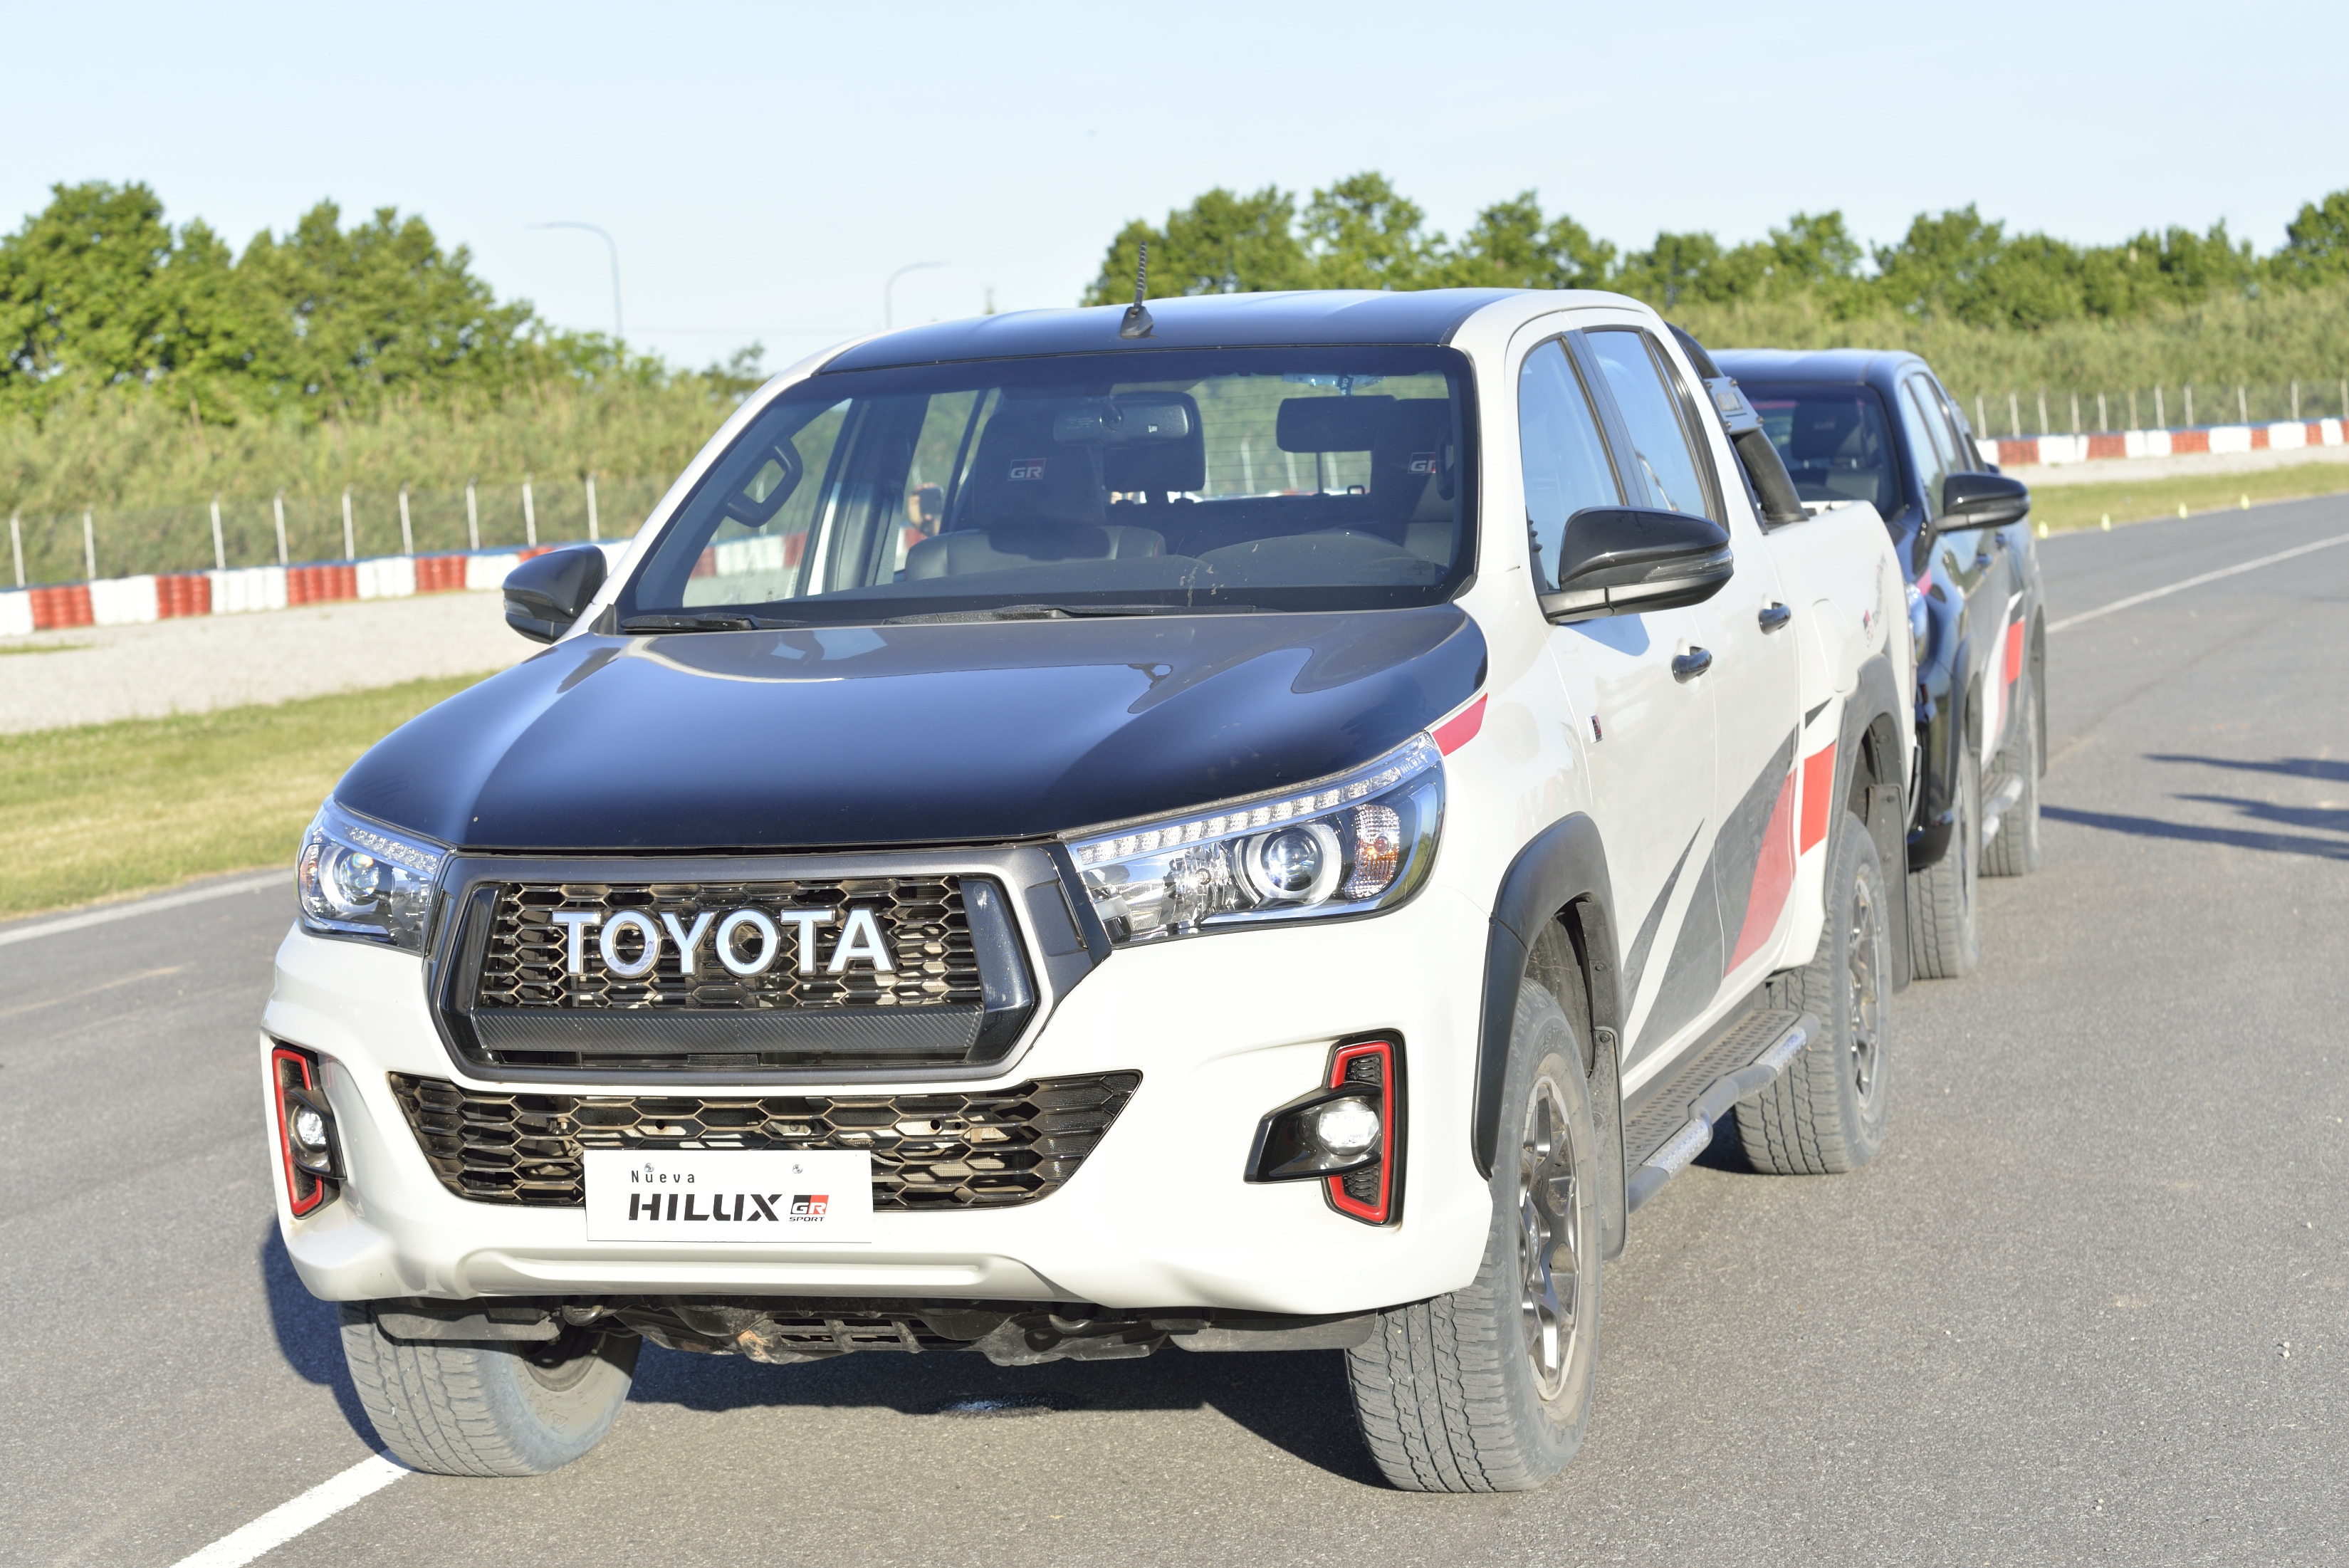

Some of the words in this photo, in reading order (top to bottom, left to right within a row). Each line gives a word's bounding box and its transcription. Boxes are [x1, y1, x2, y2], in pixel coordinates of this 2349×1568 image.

[1010, 466, 1043, 479] GR
[552, 906, 896, 978] TOYOTA
[631, 1170, 695, 1183] Nueva
[629, 1193, 783, 1221] HILUX
[791, 1201, 827, 1215] GR
